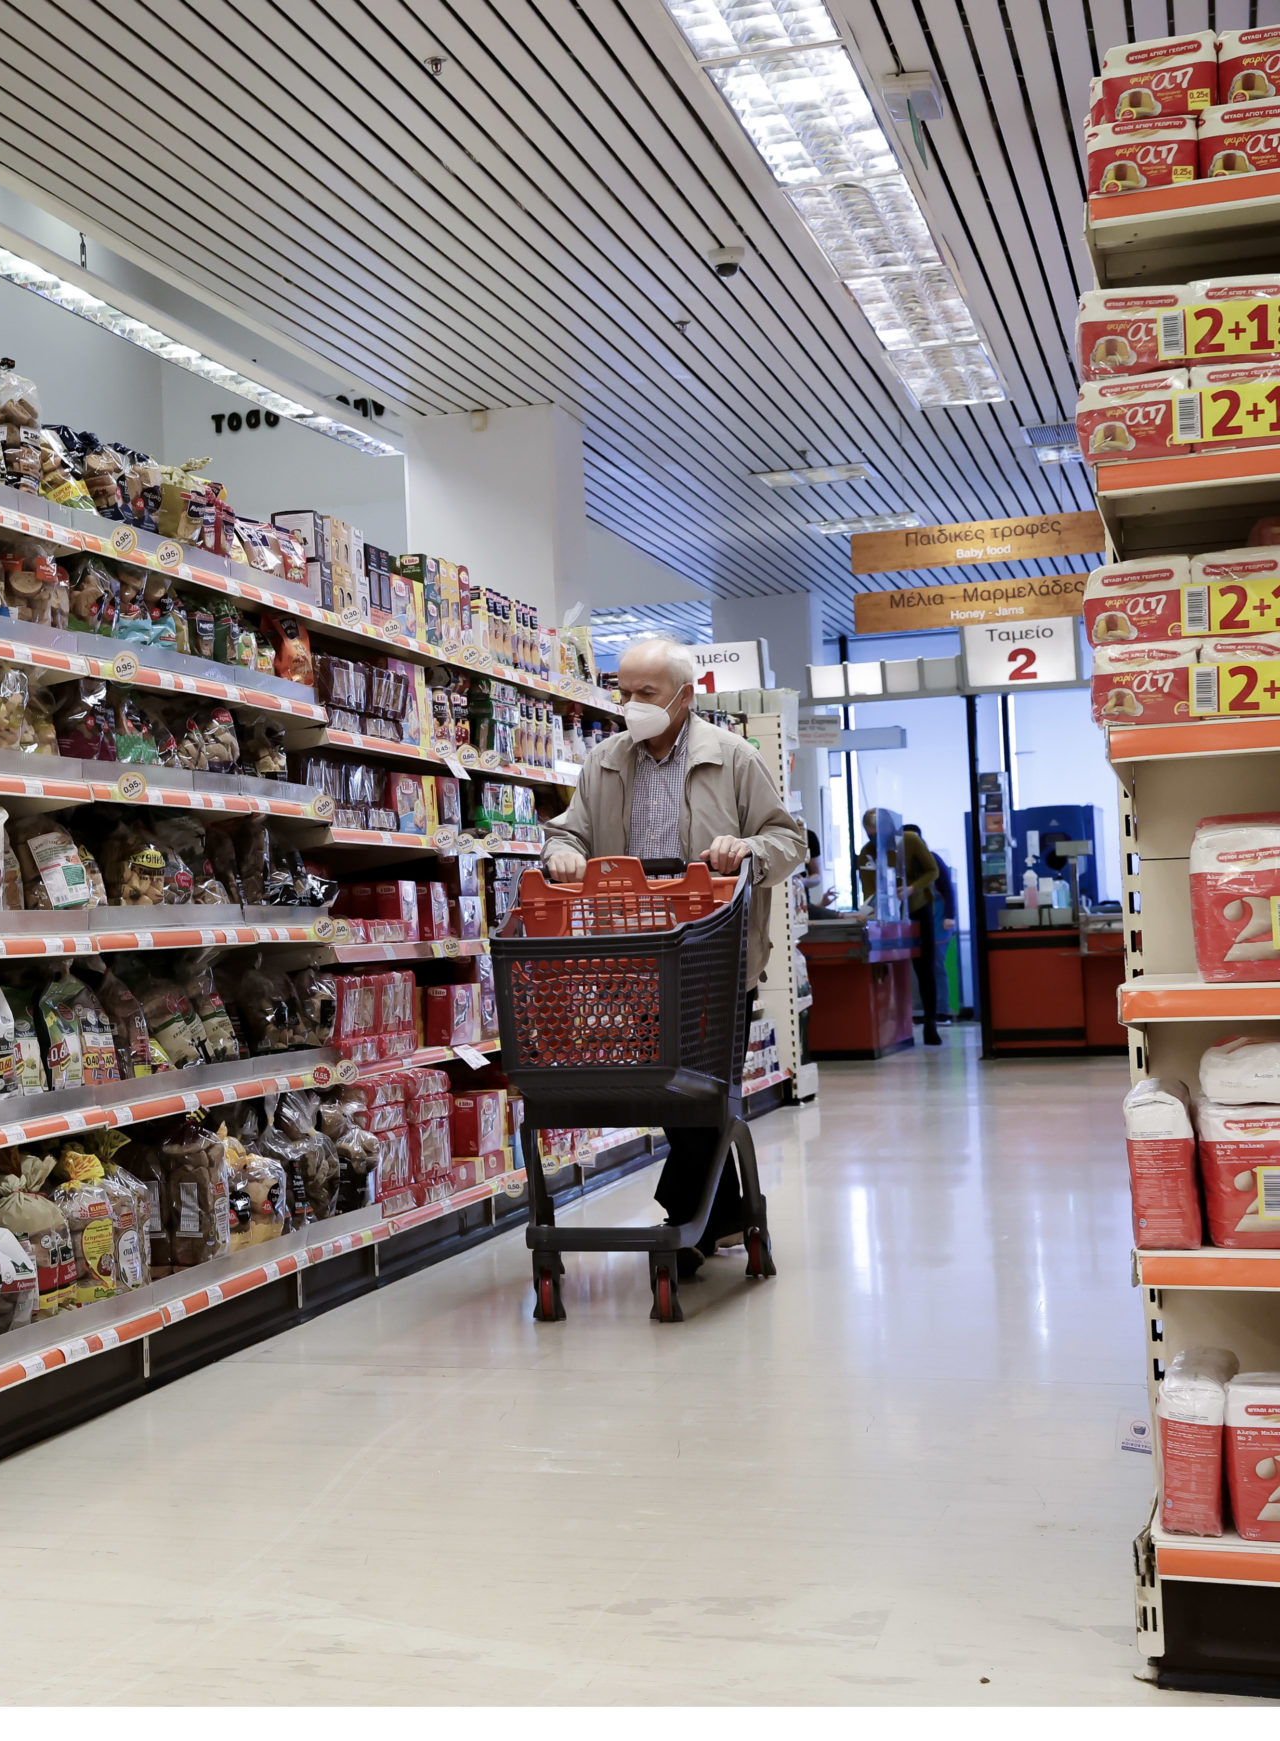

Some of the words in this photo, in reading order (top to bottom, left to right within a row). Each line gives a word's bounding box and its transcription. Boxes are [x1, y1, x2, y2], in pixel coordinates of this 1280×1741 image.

[1193, 303, 1275, 355] 2+1
[905, 527, 985, 548] Παιδικές
[990, 518, 1062, 541] τροφές
[956, 547, 984, 560] Baby
[986, 544, 1011, 556] food
[889, 591, 944, 609] Μέλια
[963, 580, 1086, 605] Μαρμελάδες
[950, 608, 986, 621] Honey
[995, 605, 1025, 616] Jams
[985, 625, 1054, 643] Ταμείο
[1007, 648, 1038, 681] 2
[697, 671, 716, 693] 1
